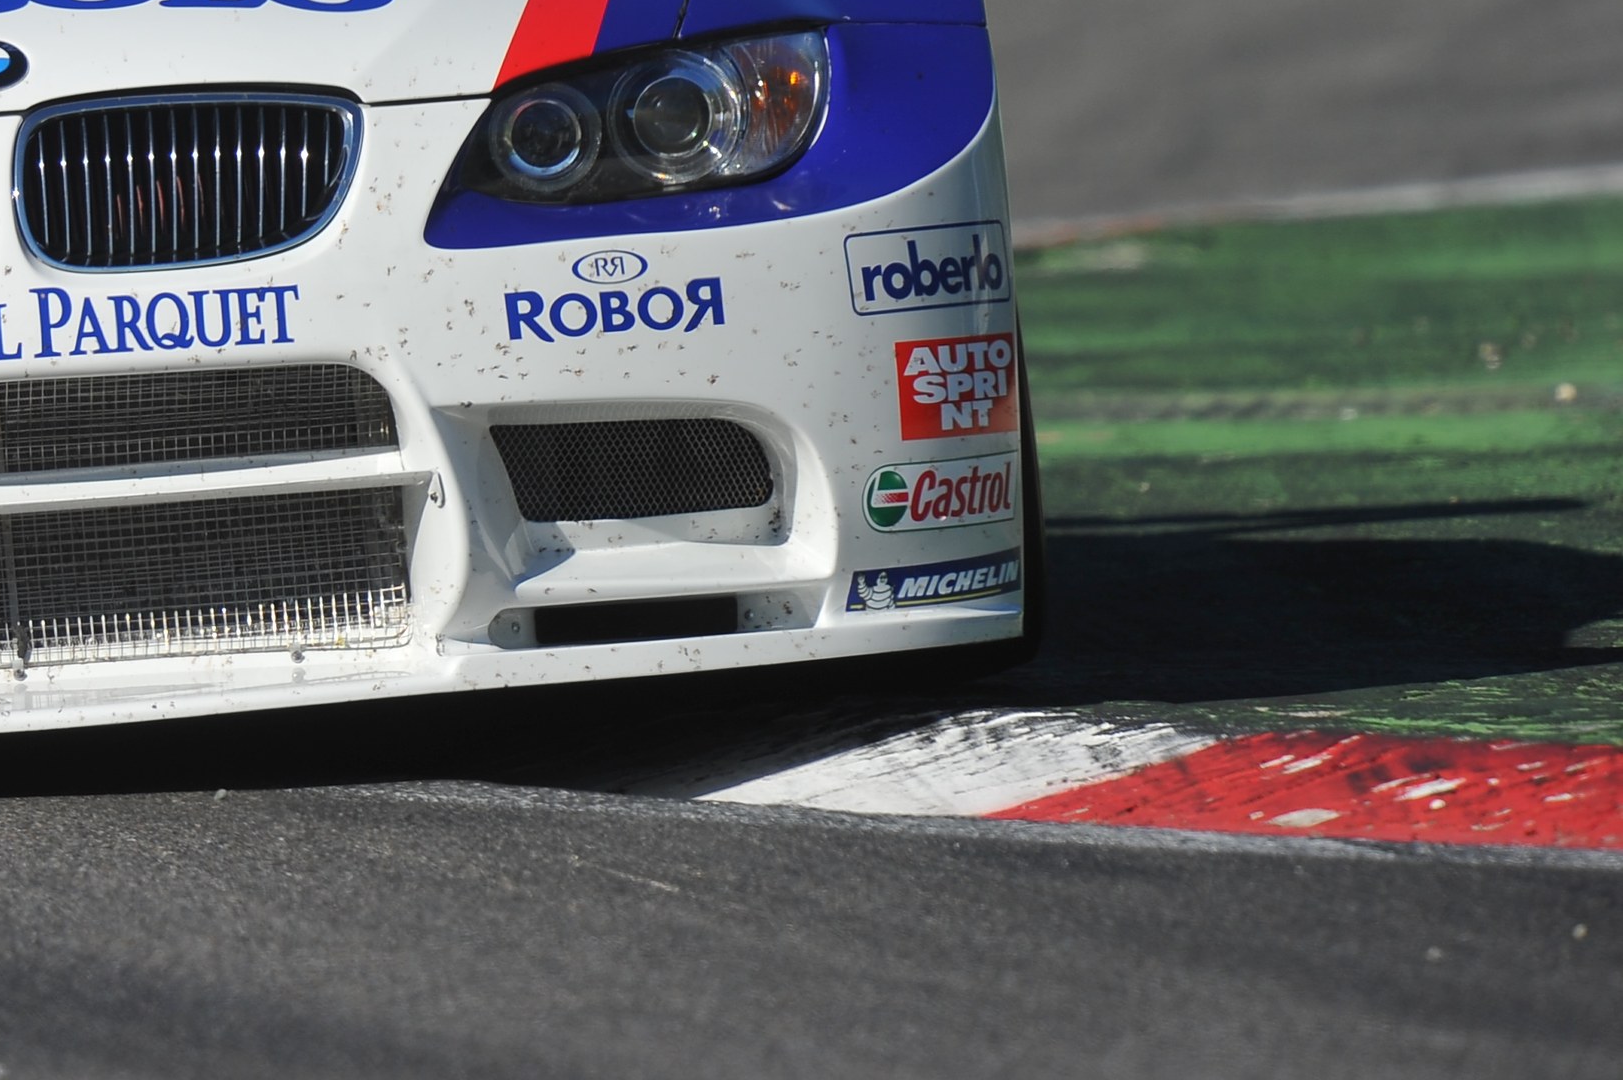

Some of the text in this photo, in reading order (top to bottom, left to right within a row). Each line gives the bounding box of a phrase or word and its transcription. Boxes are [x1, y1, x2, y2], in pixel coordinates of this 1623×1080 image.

[861, 234, 1004, 301] roberlo
[29, 285, 299, 359] PARQUET
[903, 338, 1012, 376] AUTO
[912, 369, 1009, 404] SPRI
[940, 399, 994, 431] NT
[910, 473, 1012, 522] Castrol
[898, 560, 1020, 599] MICHELIN
